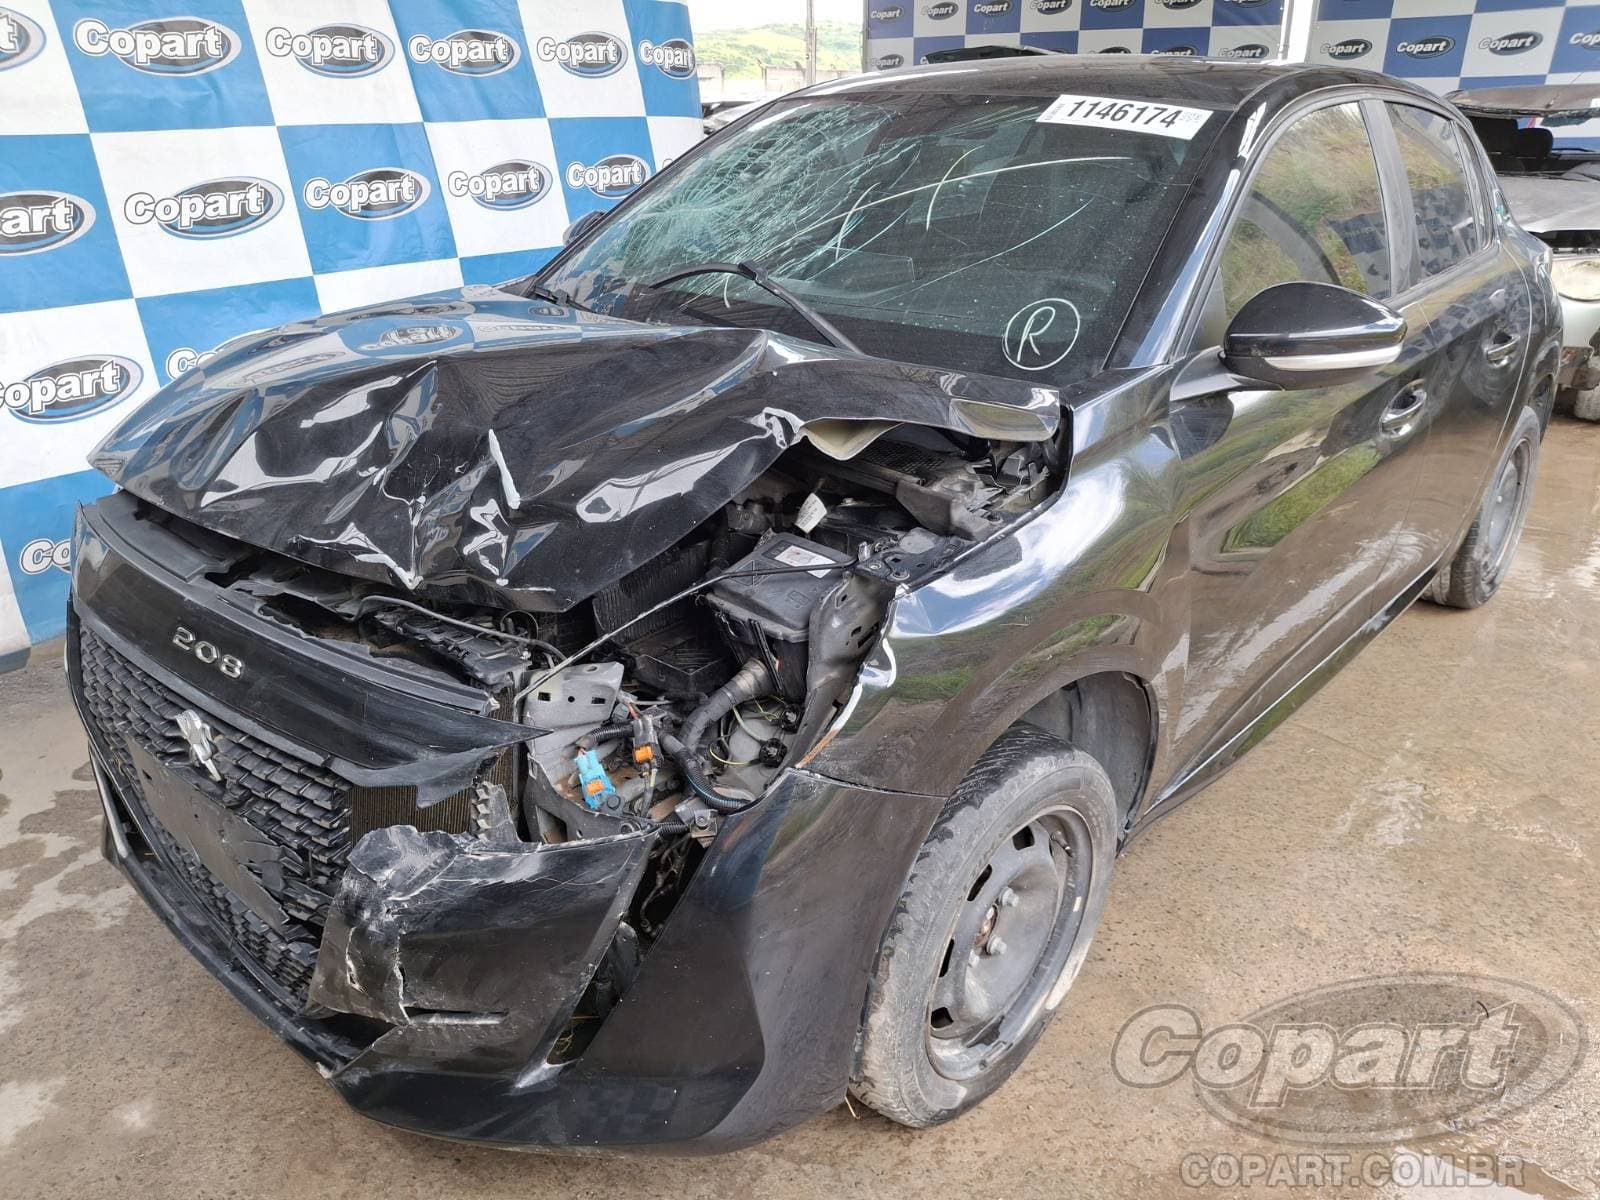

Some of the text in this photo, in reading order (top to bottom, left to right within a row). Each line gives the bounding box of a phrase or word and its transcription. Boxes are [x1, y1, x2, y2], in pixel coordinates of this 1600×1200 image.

[871, 9, 900, 19] Copart
[921, 5, 953, 16] Copart
[974, 3, 1008, 13] Copart
[1030, 0, 1065, 10] Copart
[75, 19, 223, 65] Copart
[266, 27, 378, 64] Copart
[409, 34, 507, 67] Copart
[537, 37, 618, 65] Copart
[1219, 48, 1262, 58] Copart
[1320, 43, 1365, 55] Copart
[1397, 41, 1447, 54] Copart
[1479, 34, 1535, 50] Copart
[1570, 32, 1600, 46] Cop
[871, 57, 900, 67] Copart
[1068, 100, 1183, 128] 1146174
[448, 166, 540, 200] Copart
[567, 160, 641, 190] Copart
[124, 183, 264, 228] Copart
[305, 175, 415, 210] Copart
[0, 196, 73, 237] art
[1017, 306, 1055, 362] R
[172, 626, 244, 679] 208
